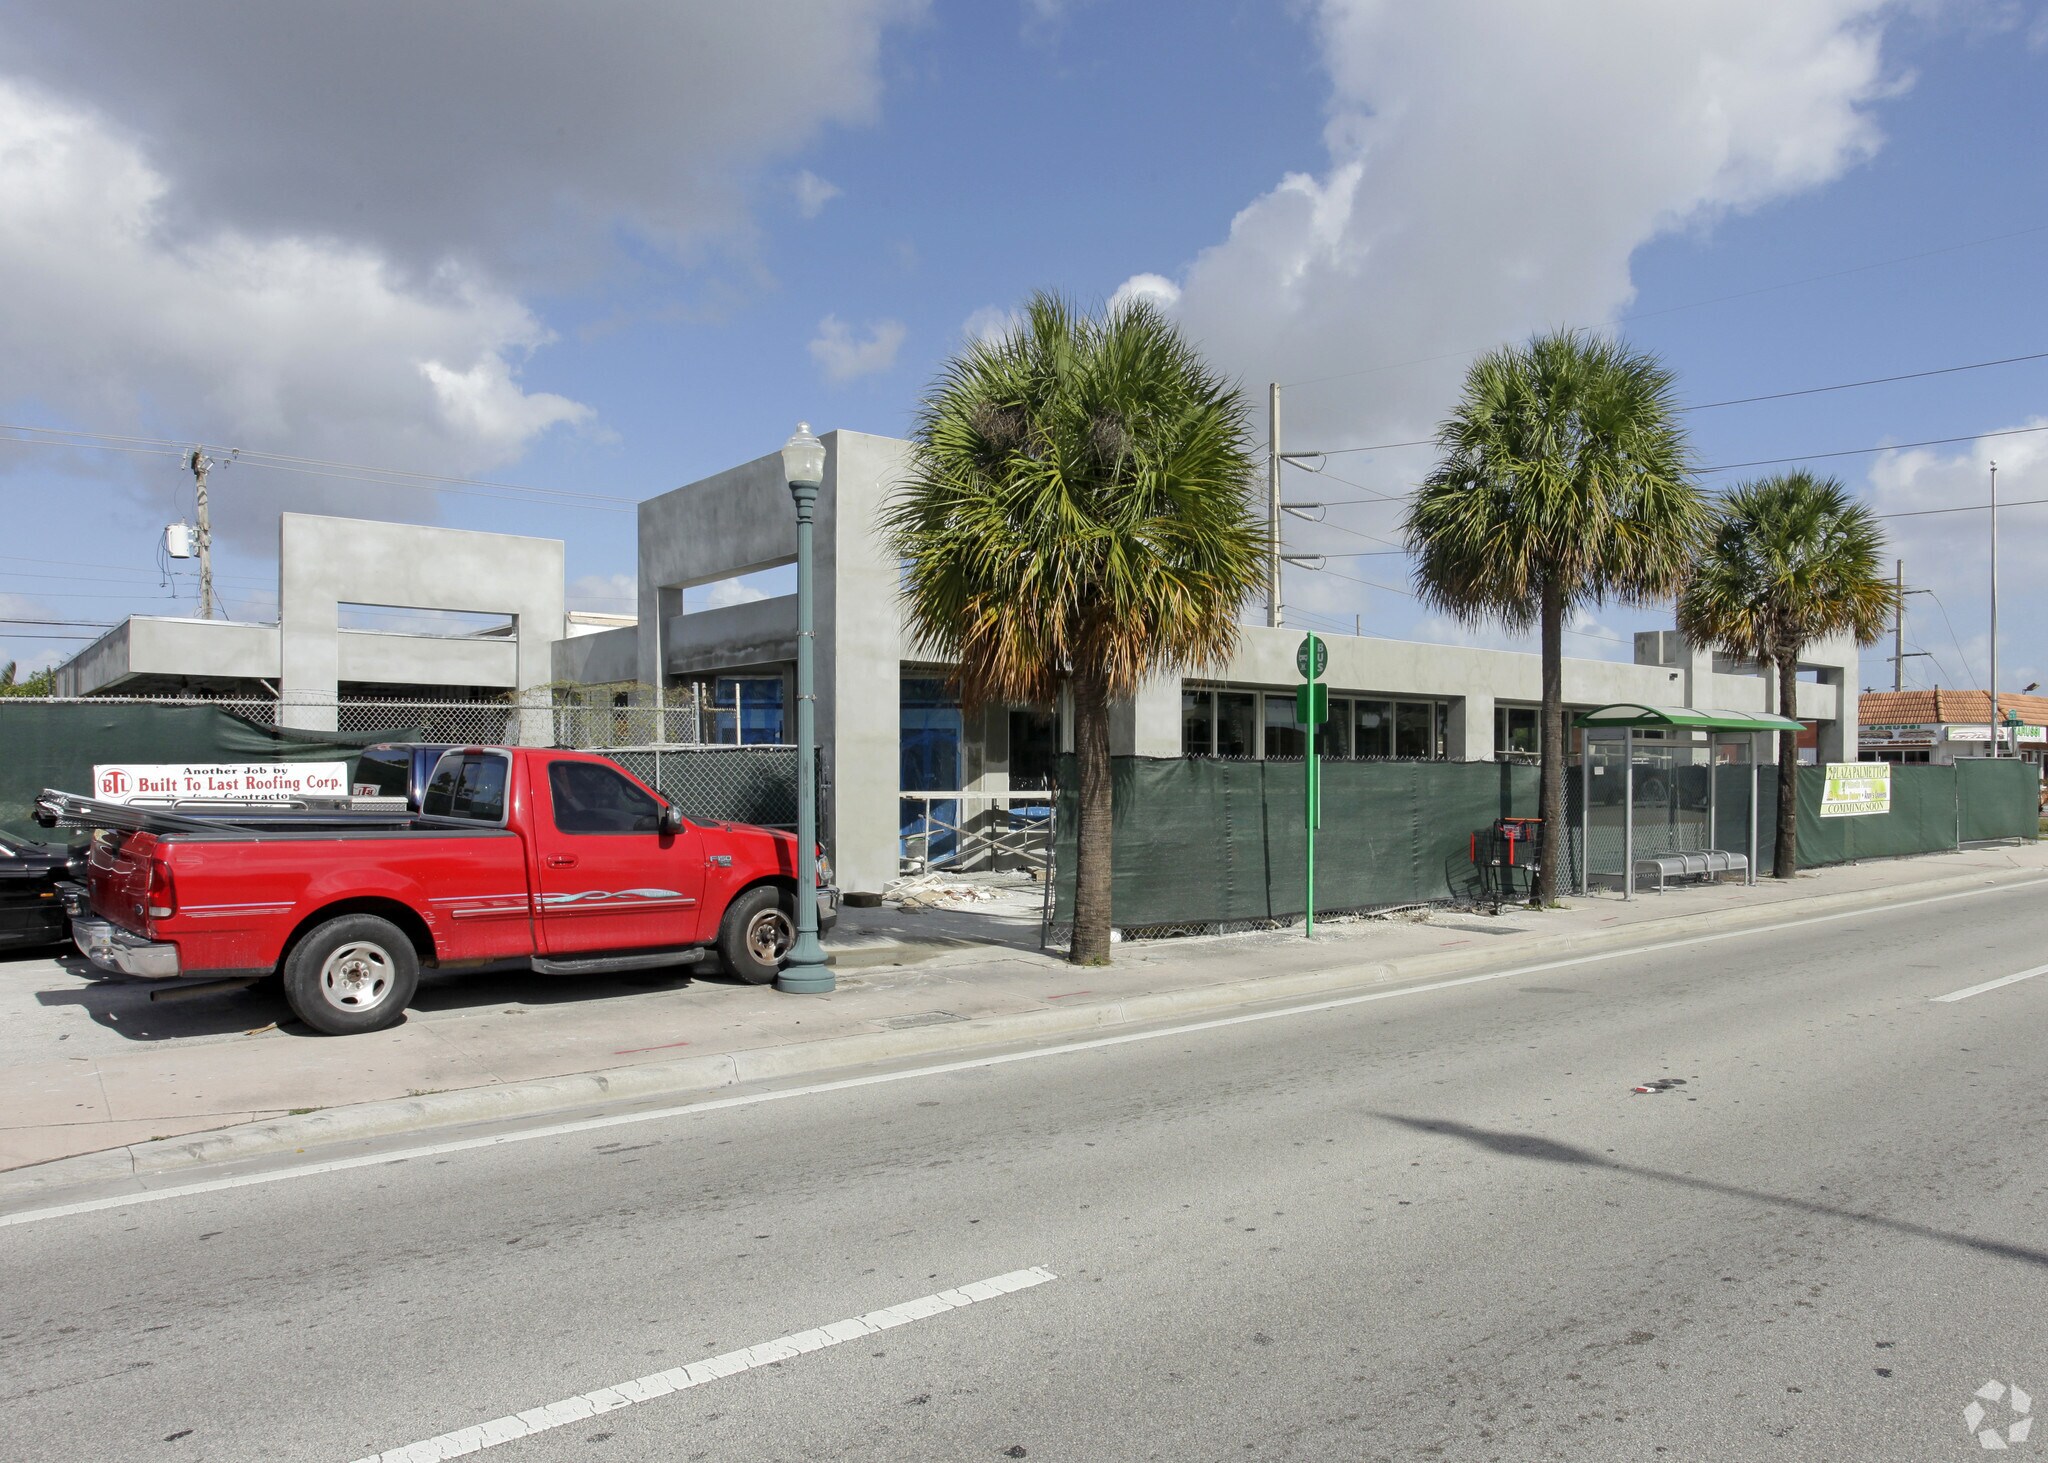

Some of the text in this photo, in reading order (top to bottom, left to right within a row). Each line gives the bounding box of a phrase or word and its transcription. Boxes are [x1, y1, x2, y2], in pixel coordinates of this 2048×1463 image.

[183, 766, 288, 776] Another Job by
[1832, 766, 1884, 779] PLAZA PALMETTO
[102, 771, 129, 794] BTL
[139, 775, 342, 792] Built To Last Roofing Corp.
[1828, 801, 1884, 814] COMMING SOON
